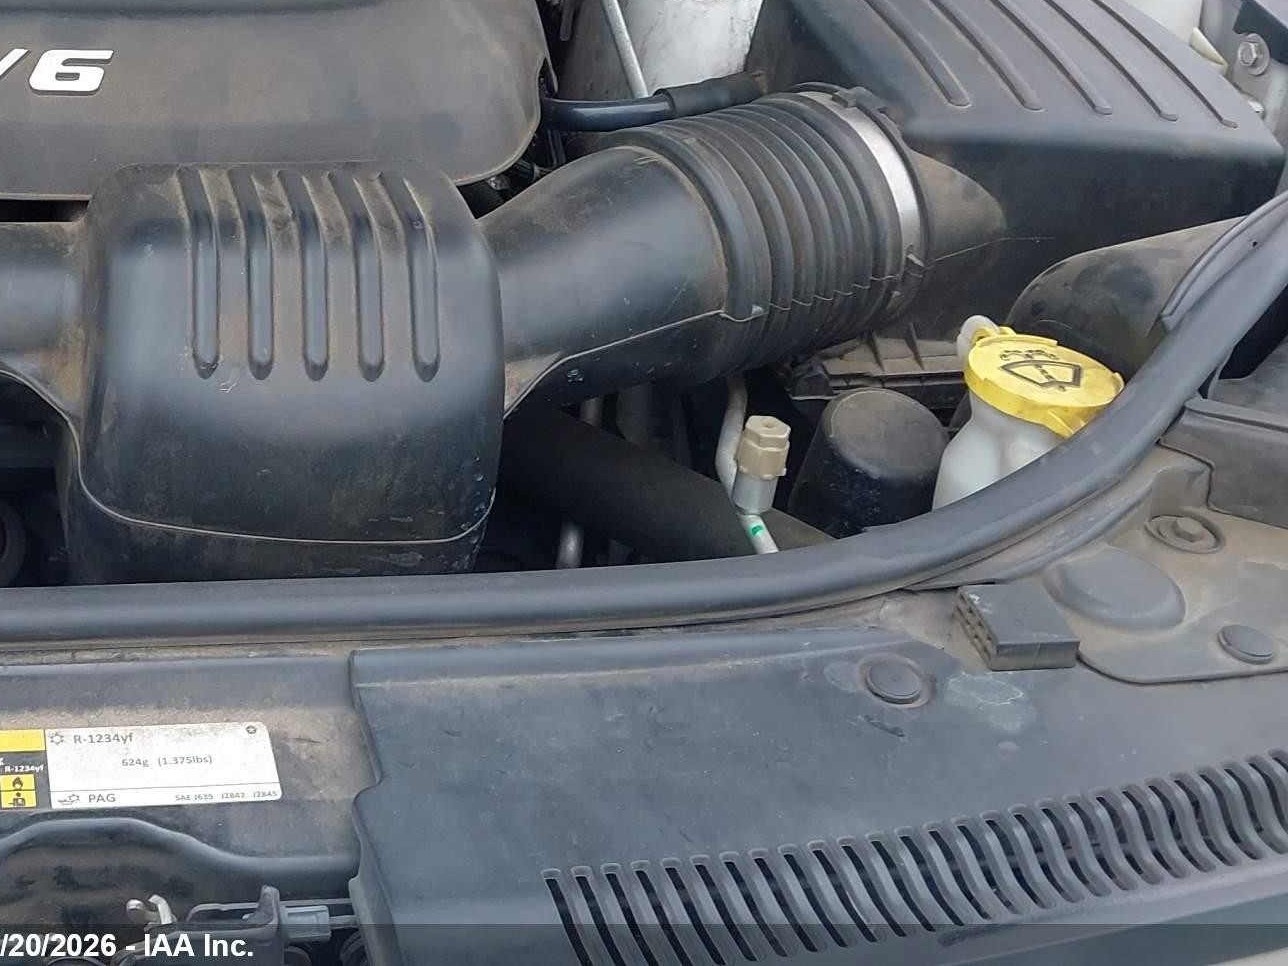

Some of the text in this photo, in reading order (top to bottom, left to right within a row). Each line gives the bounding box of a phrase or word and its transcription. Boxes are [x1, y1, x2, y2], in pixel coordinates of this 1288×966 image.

[73, 733, 133, 745] R-1234yf
[121, 753, 213, 768] 624g (1.375lbs)
[4, 764, 44, 773] R-1234yf
[88, 793, 116, 804] PAG
[175, 794, 190, 802] SAE
